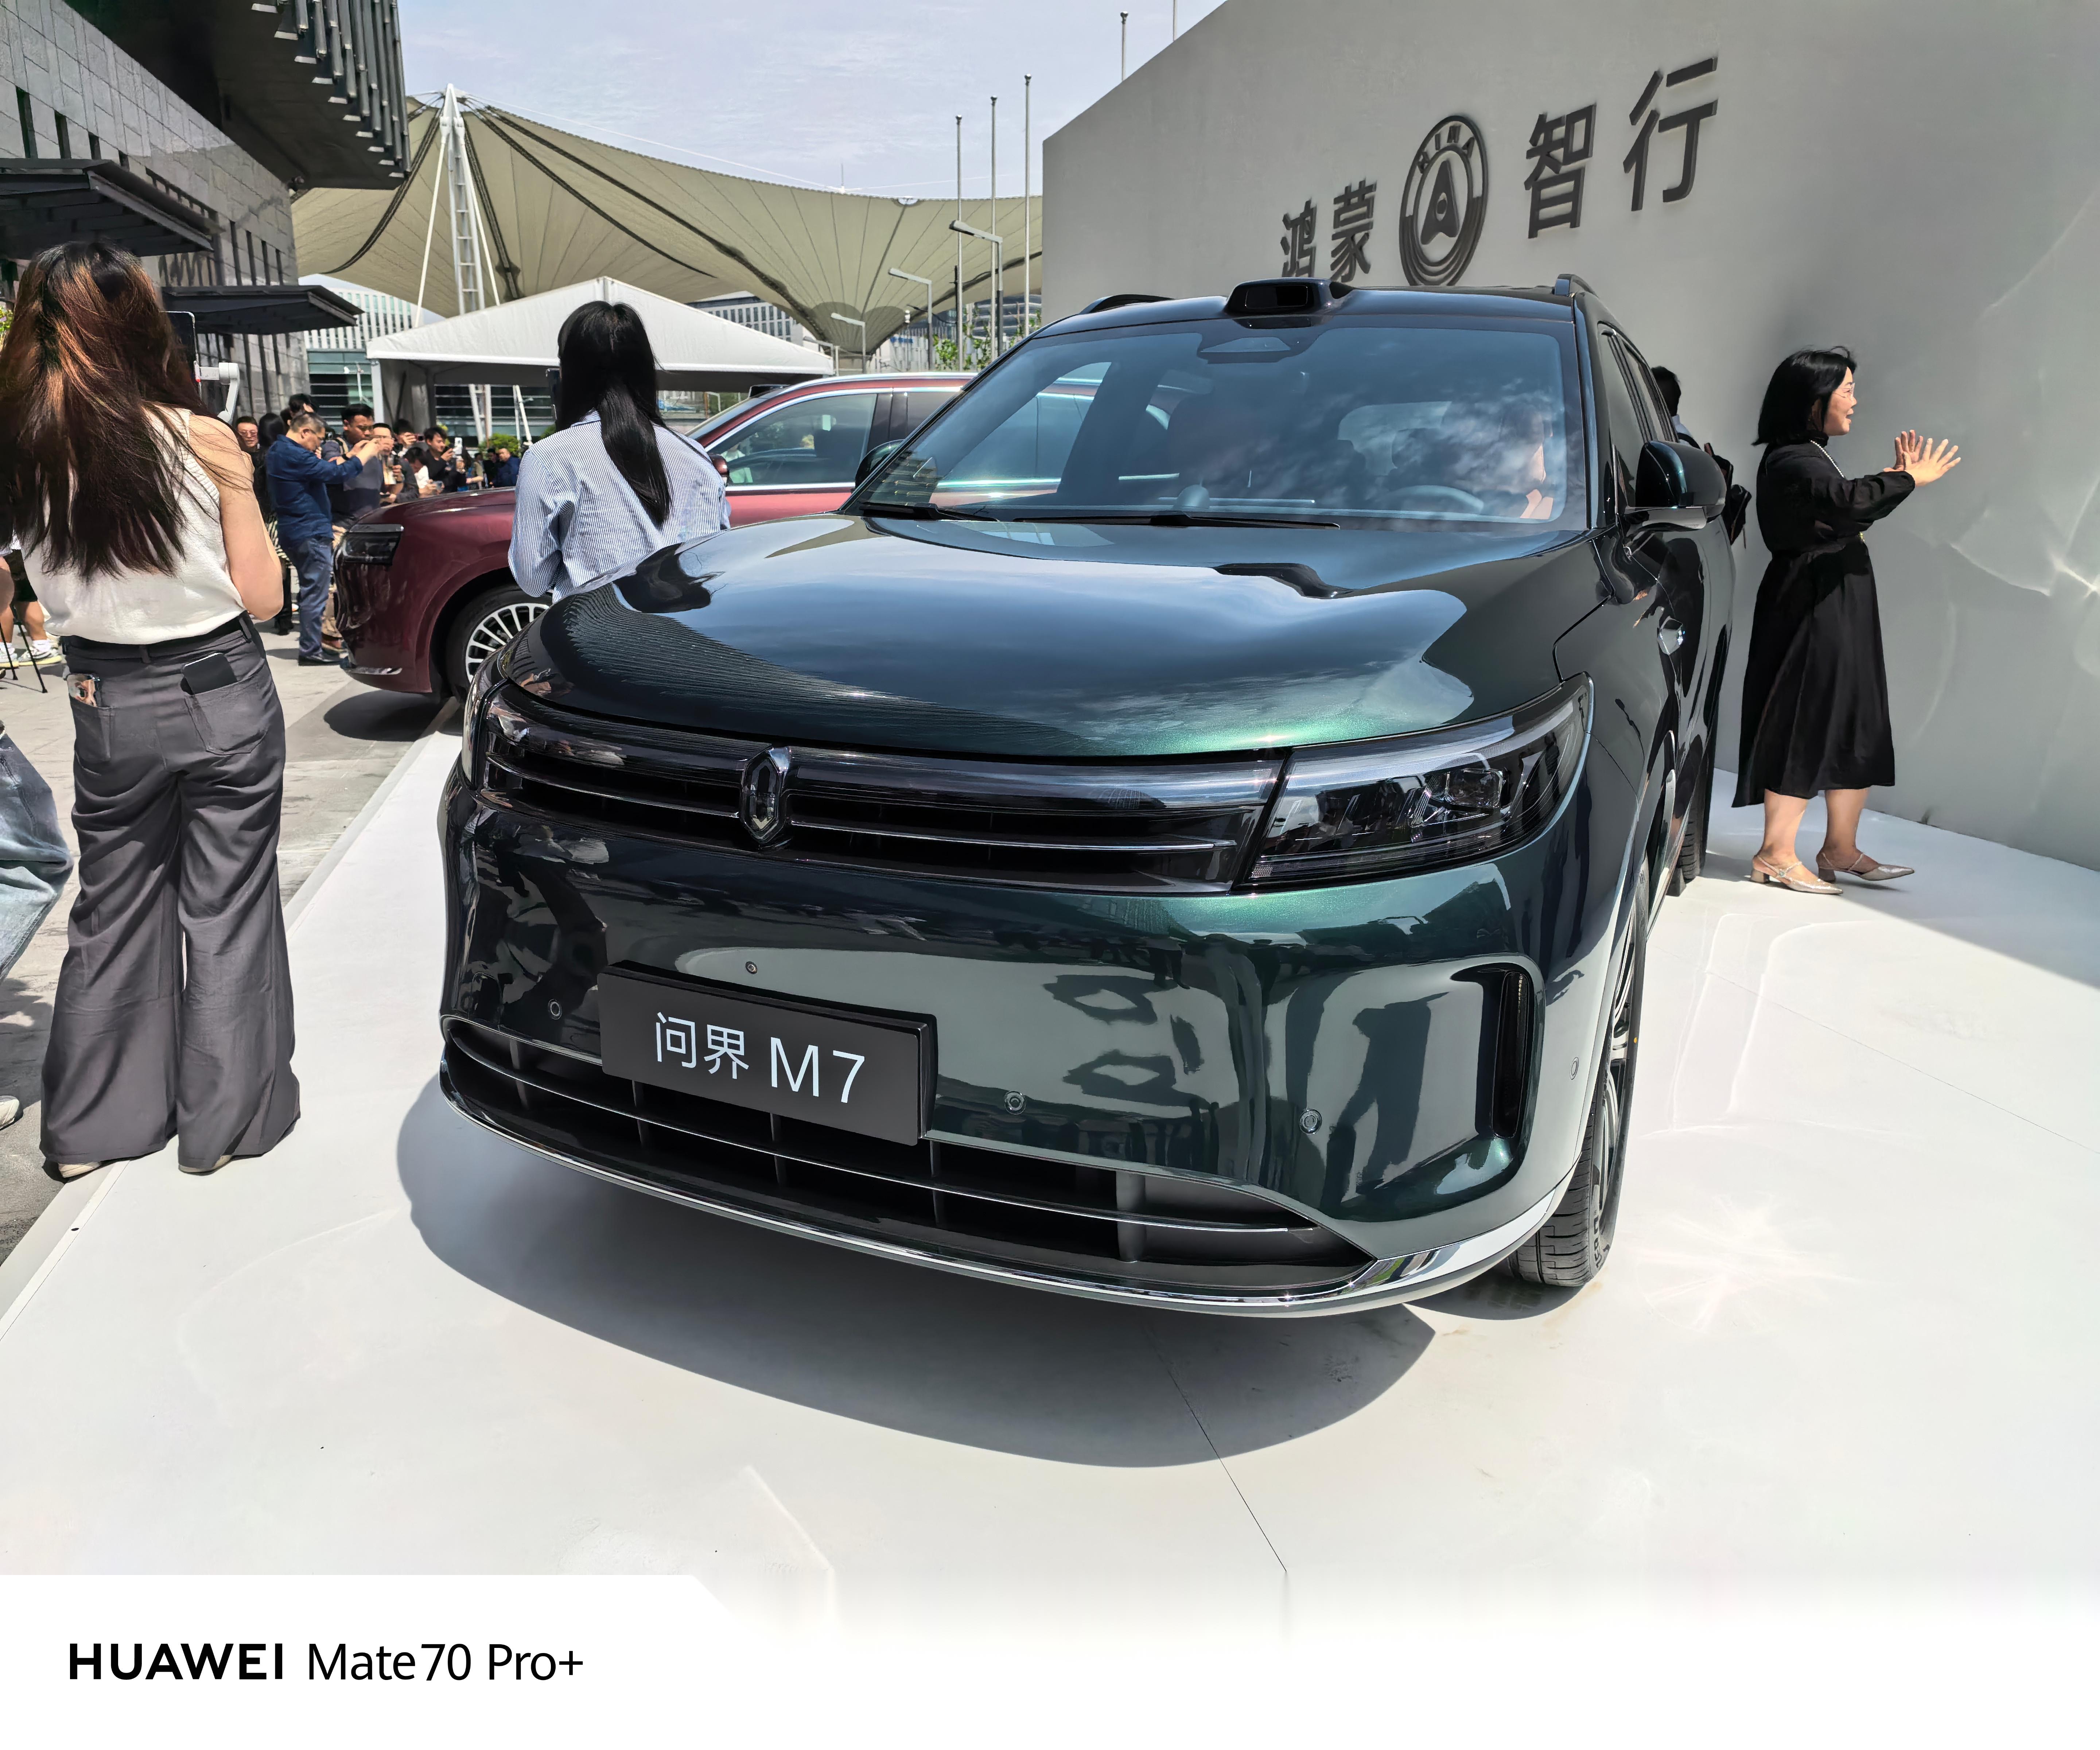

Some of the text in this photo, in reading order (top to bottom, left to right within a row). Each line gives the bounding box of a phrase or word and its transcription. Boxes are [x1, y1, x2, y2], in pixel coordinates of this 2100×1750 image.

[1280, 55, 1718, 283] 鸿蒙 智行
[656, 1012, 865, 1103] 问界 M7
